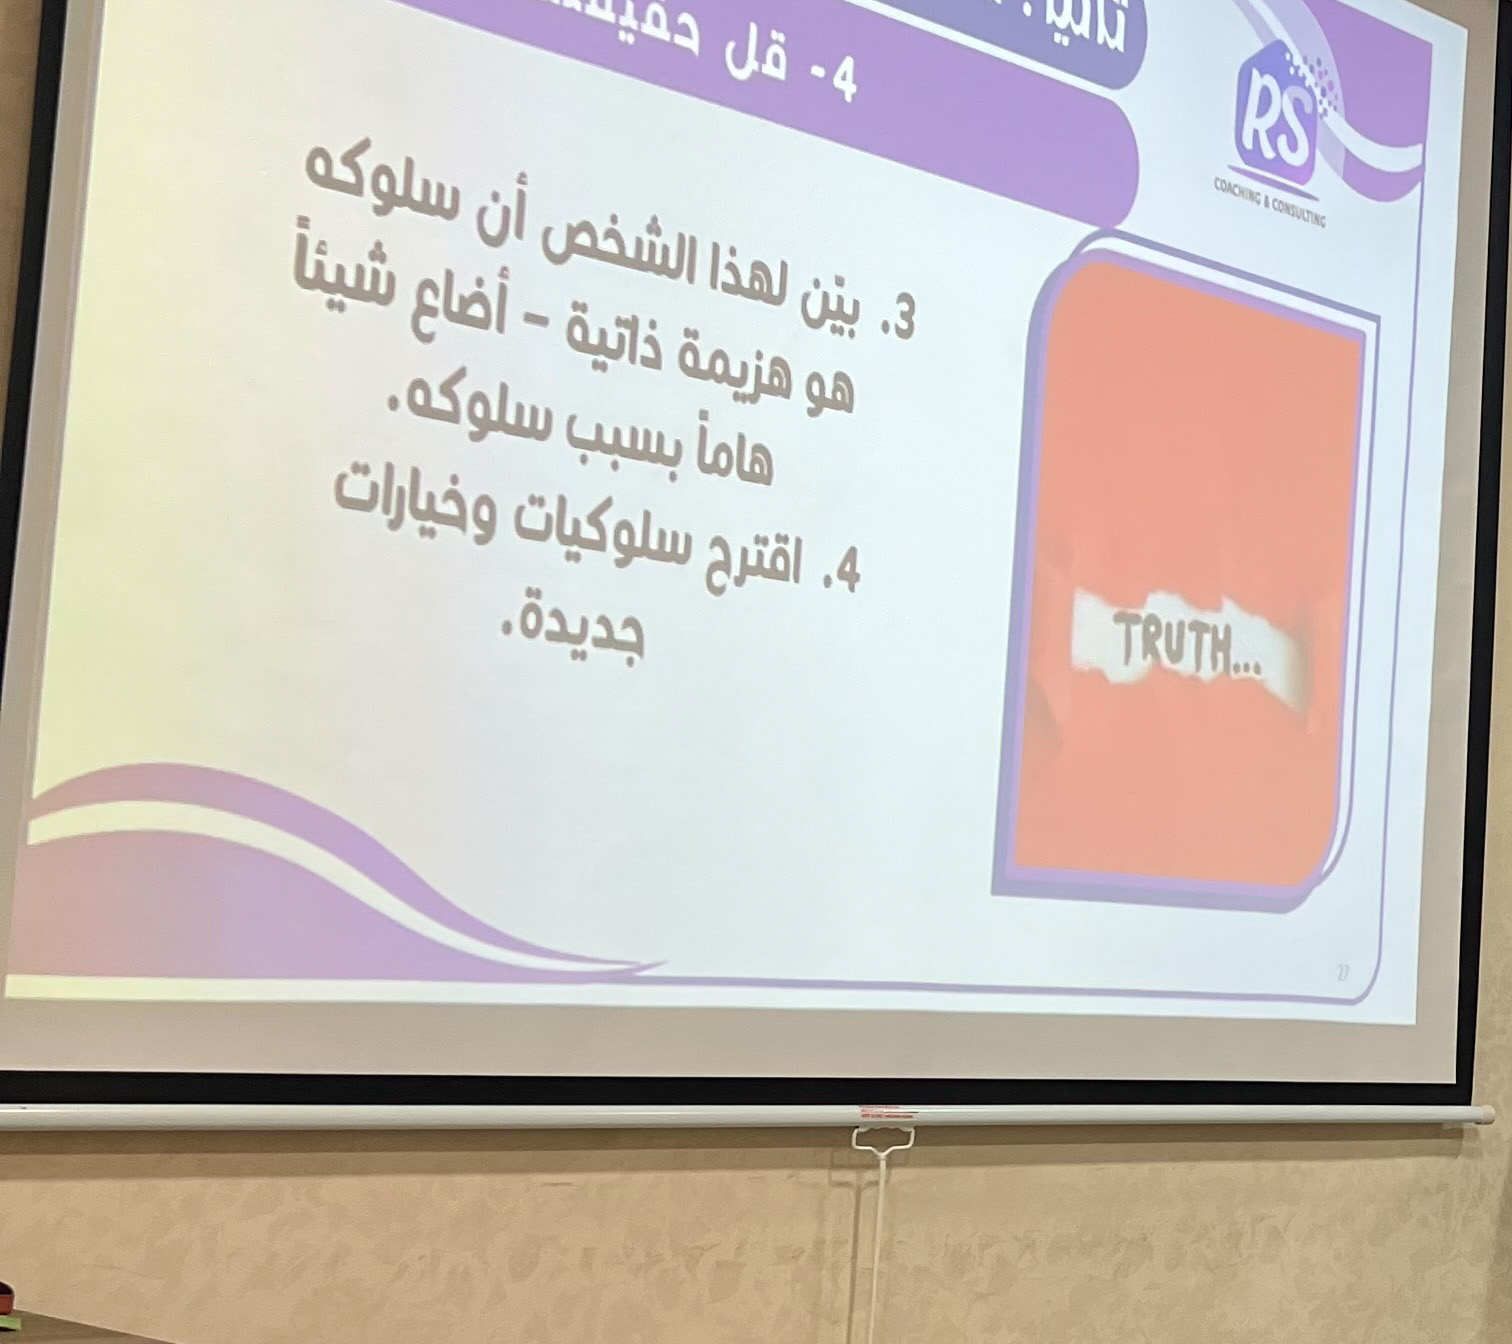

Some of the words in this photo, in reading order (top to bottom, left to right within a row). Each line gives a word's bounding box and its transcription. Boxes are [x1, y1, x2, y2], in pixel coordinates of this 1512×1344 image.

[726, 22, 787, 81] قل
[1241, 67, 1313, 167] RS
[304, 136, 462, 222] سلوكه
[476, 171, 529, 248] أن
[1214, 176, 1261, 207] COACHING
[1263, 195, 1270, 208] &
[1271, 197, 1326, 229] CONSULTING
[541, 213, 698, 286] الشخص
[710, 242, 789, 308] لهذا
[410, 265, 510, 345] أضاع
[565, 299, 663, 374] ذاتية
[387, 364, 554, 443] سلوكه.
[678, 327, 793, 406] هزيمة
[806, 370, 855, 419] هو
[565, 413, 684, 484] بسبب
[333, 460, 498, 546] وخيارات
[514, 494, 693, 569] سلوكيات
[704, 533, 803, 597] اقترح
[501, 586, 645, 668] جديدة.
[1112, 611, 1262, 677] TRUTH...
